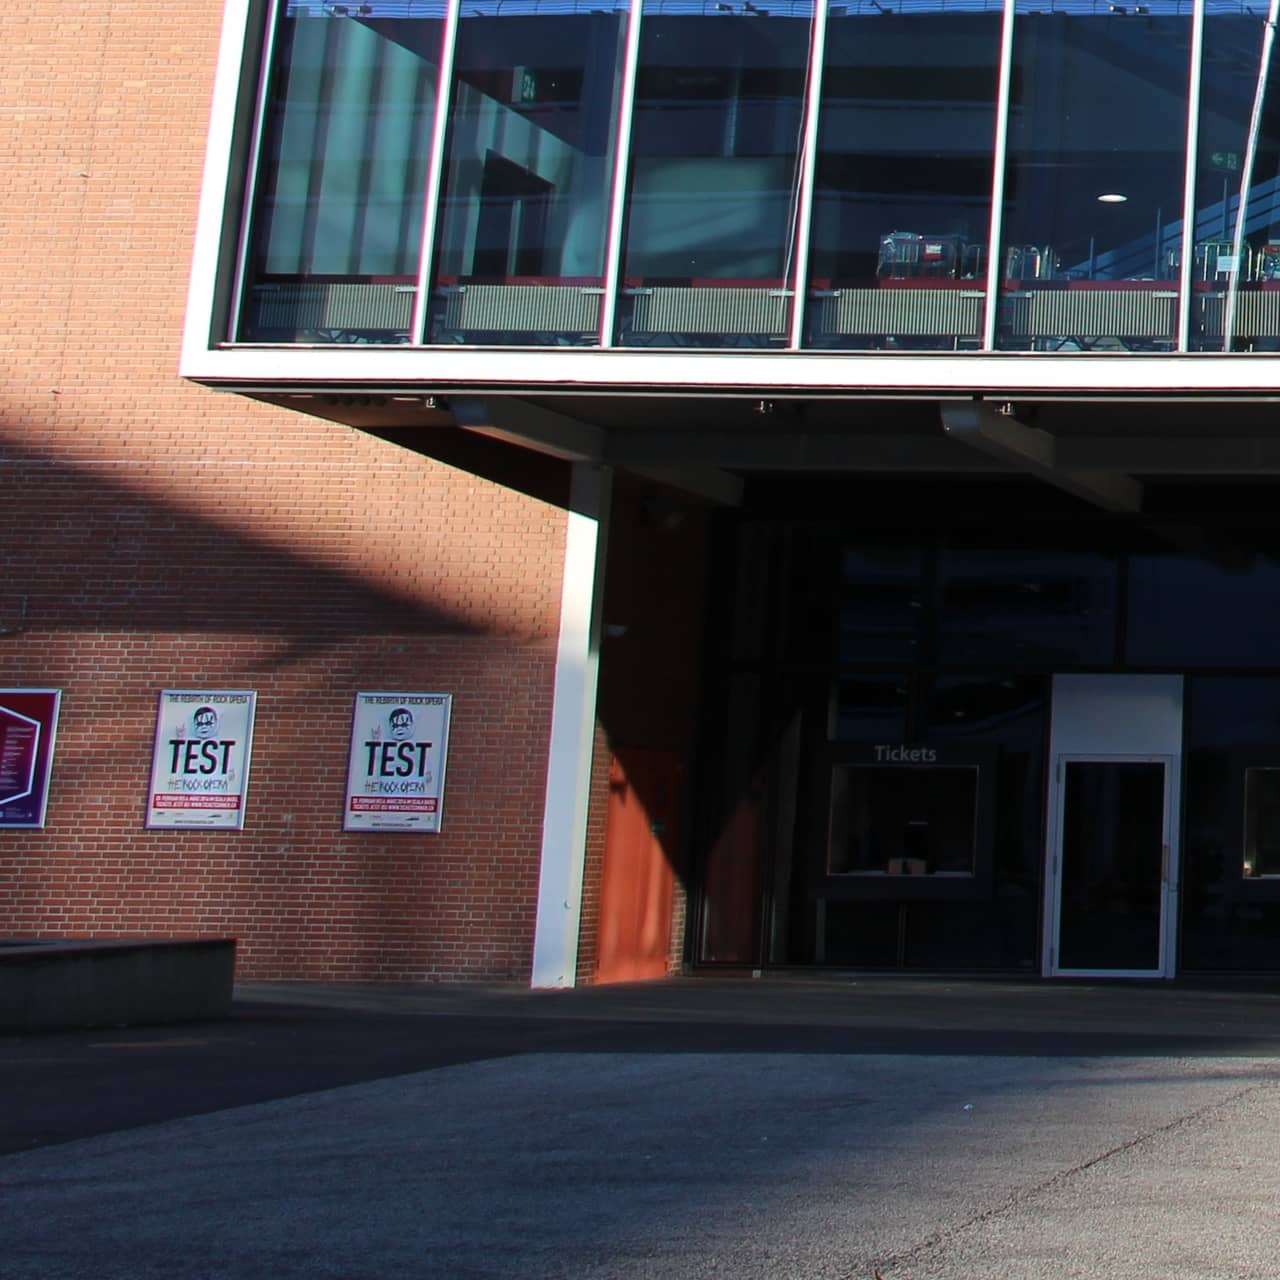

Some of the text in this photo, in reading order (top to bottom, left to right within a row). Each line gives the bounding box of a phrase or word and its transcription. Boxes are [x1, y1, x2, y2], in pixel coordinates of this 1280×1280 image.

[169, 739, 236, 775] TEST
[364, 741, 432, 777] TEST
[874, 744, 937, 762] Tickets
